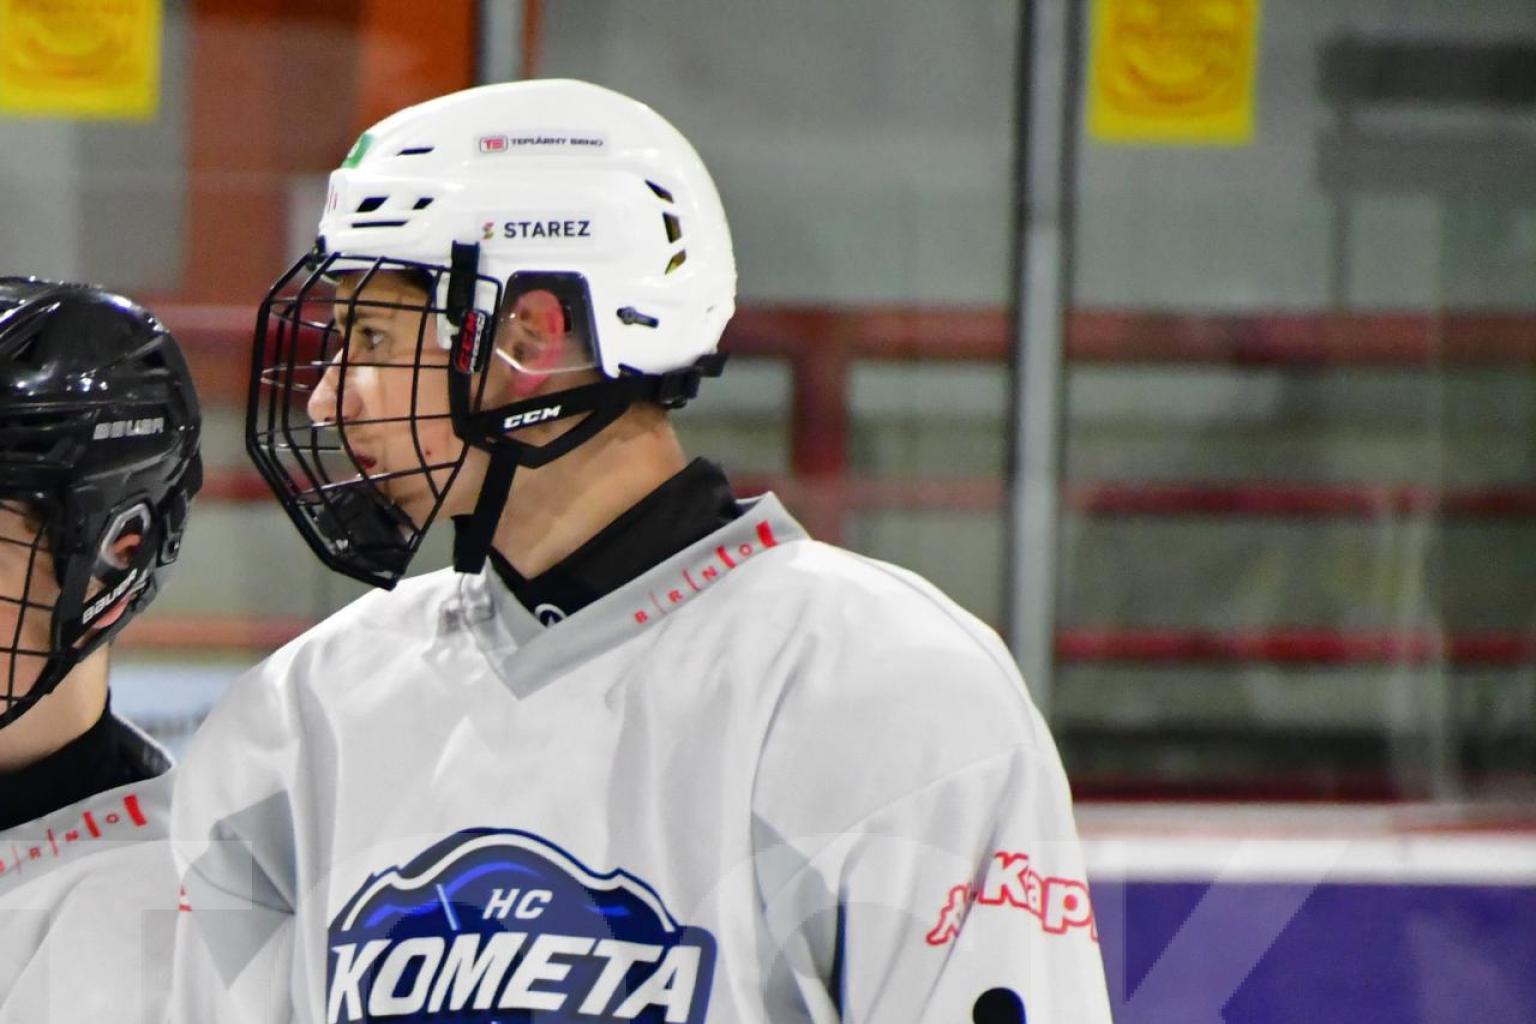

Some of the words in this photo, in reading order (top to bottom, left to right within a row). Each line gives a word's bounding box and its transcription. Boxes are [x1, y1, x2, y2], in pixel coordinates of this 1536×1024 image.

[503, 220, 591, 239] STAREZ
[504, 405, 562, 429] CCM
[482, 888, 552, 921] HC
